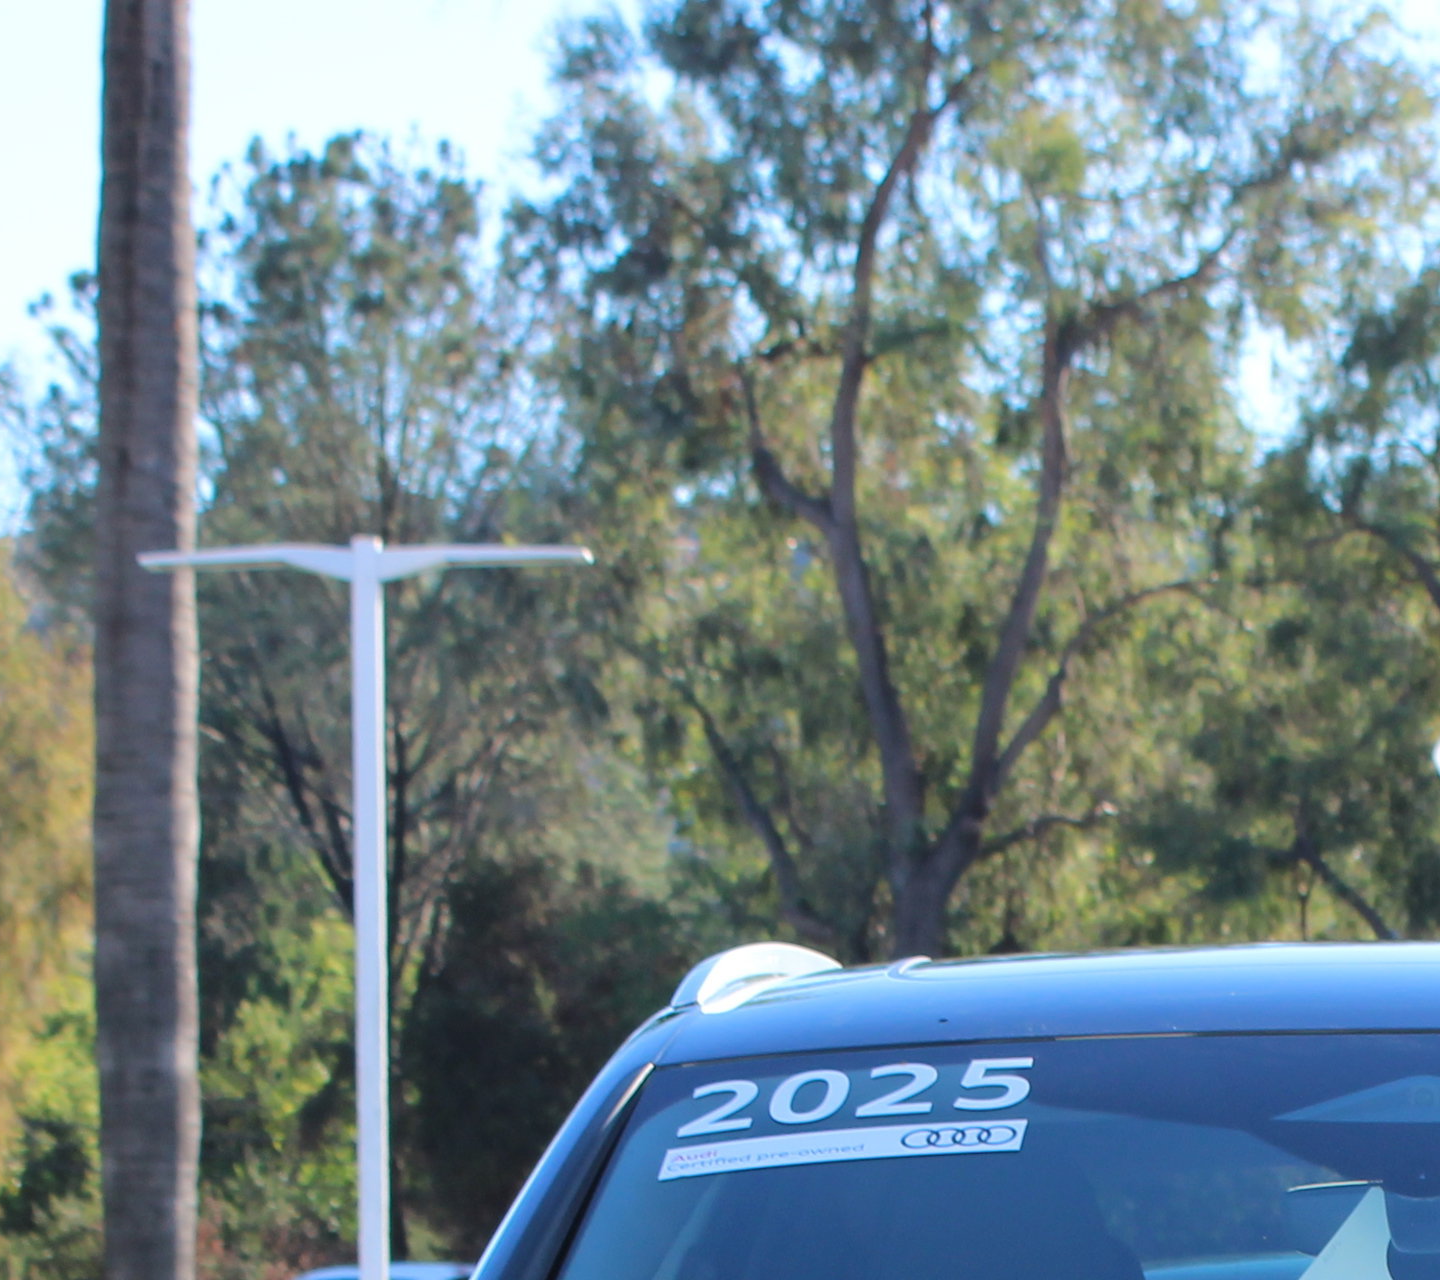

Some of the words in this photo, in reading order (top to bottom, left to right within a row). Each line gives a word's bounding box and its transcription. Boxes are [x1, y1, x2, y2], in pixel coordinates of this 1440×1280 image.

[676, 1057, 1034, 1138] 2025
[667, 1153, 752, 1172] Certified
[756, 1144, 865, 1163] pre-owned
[671, 1150, 718, 1162] Audi
